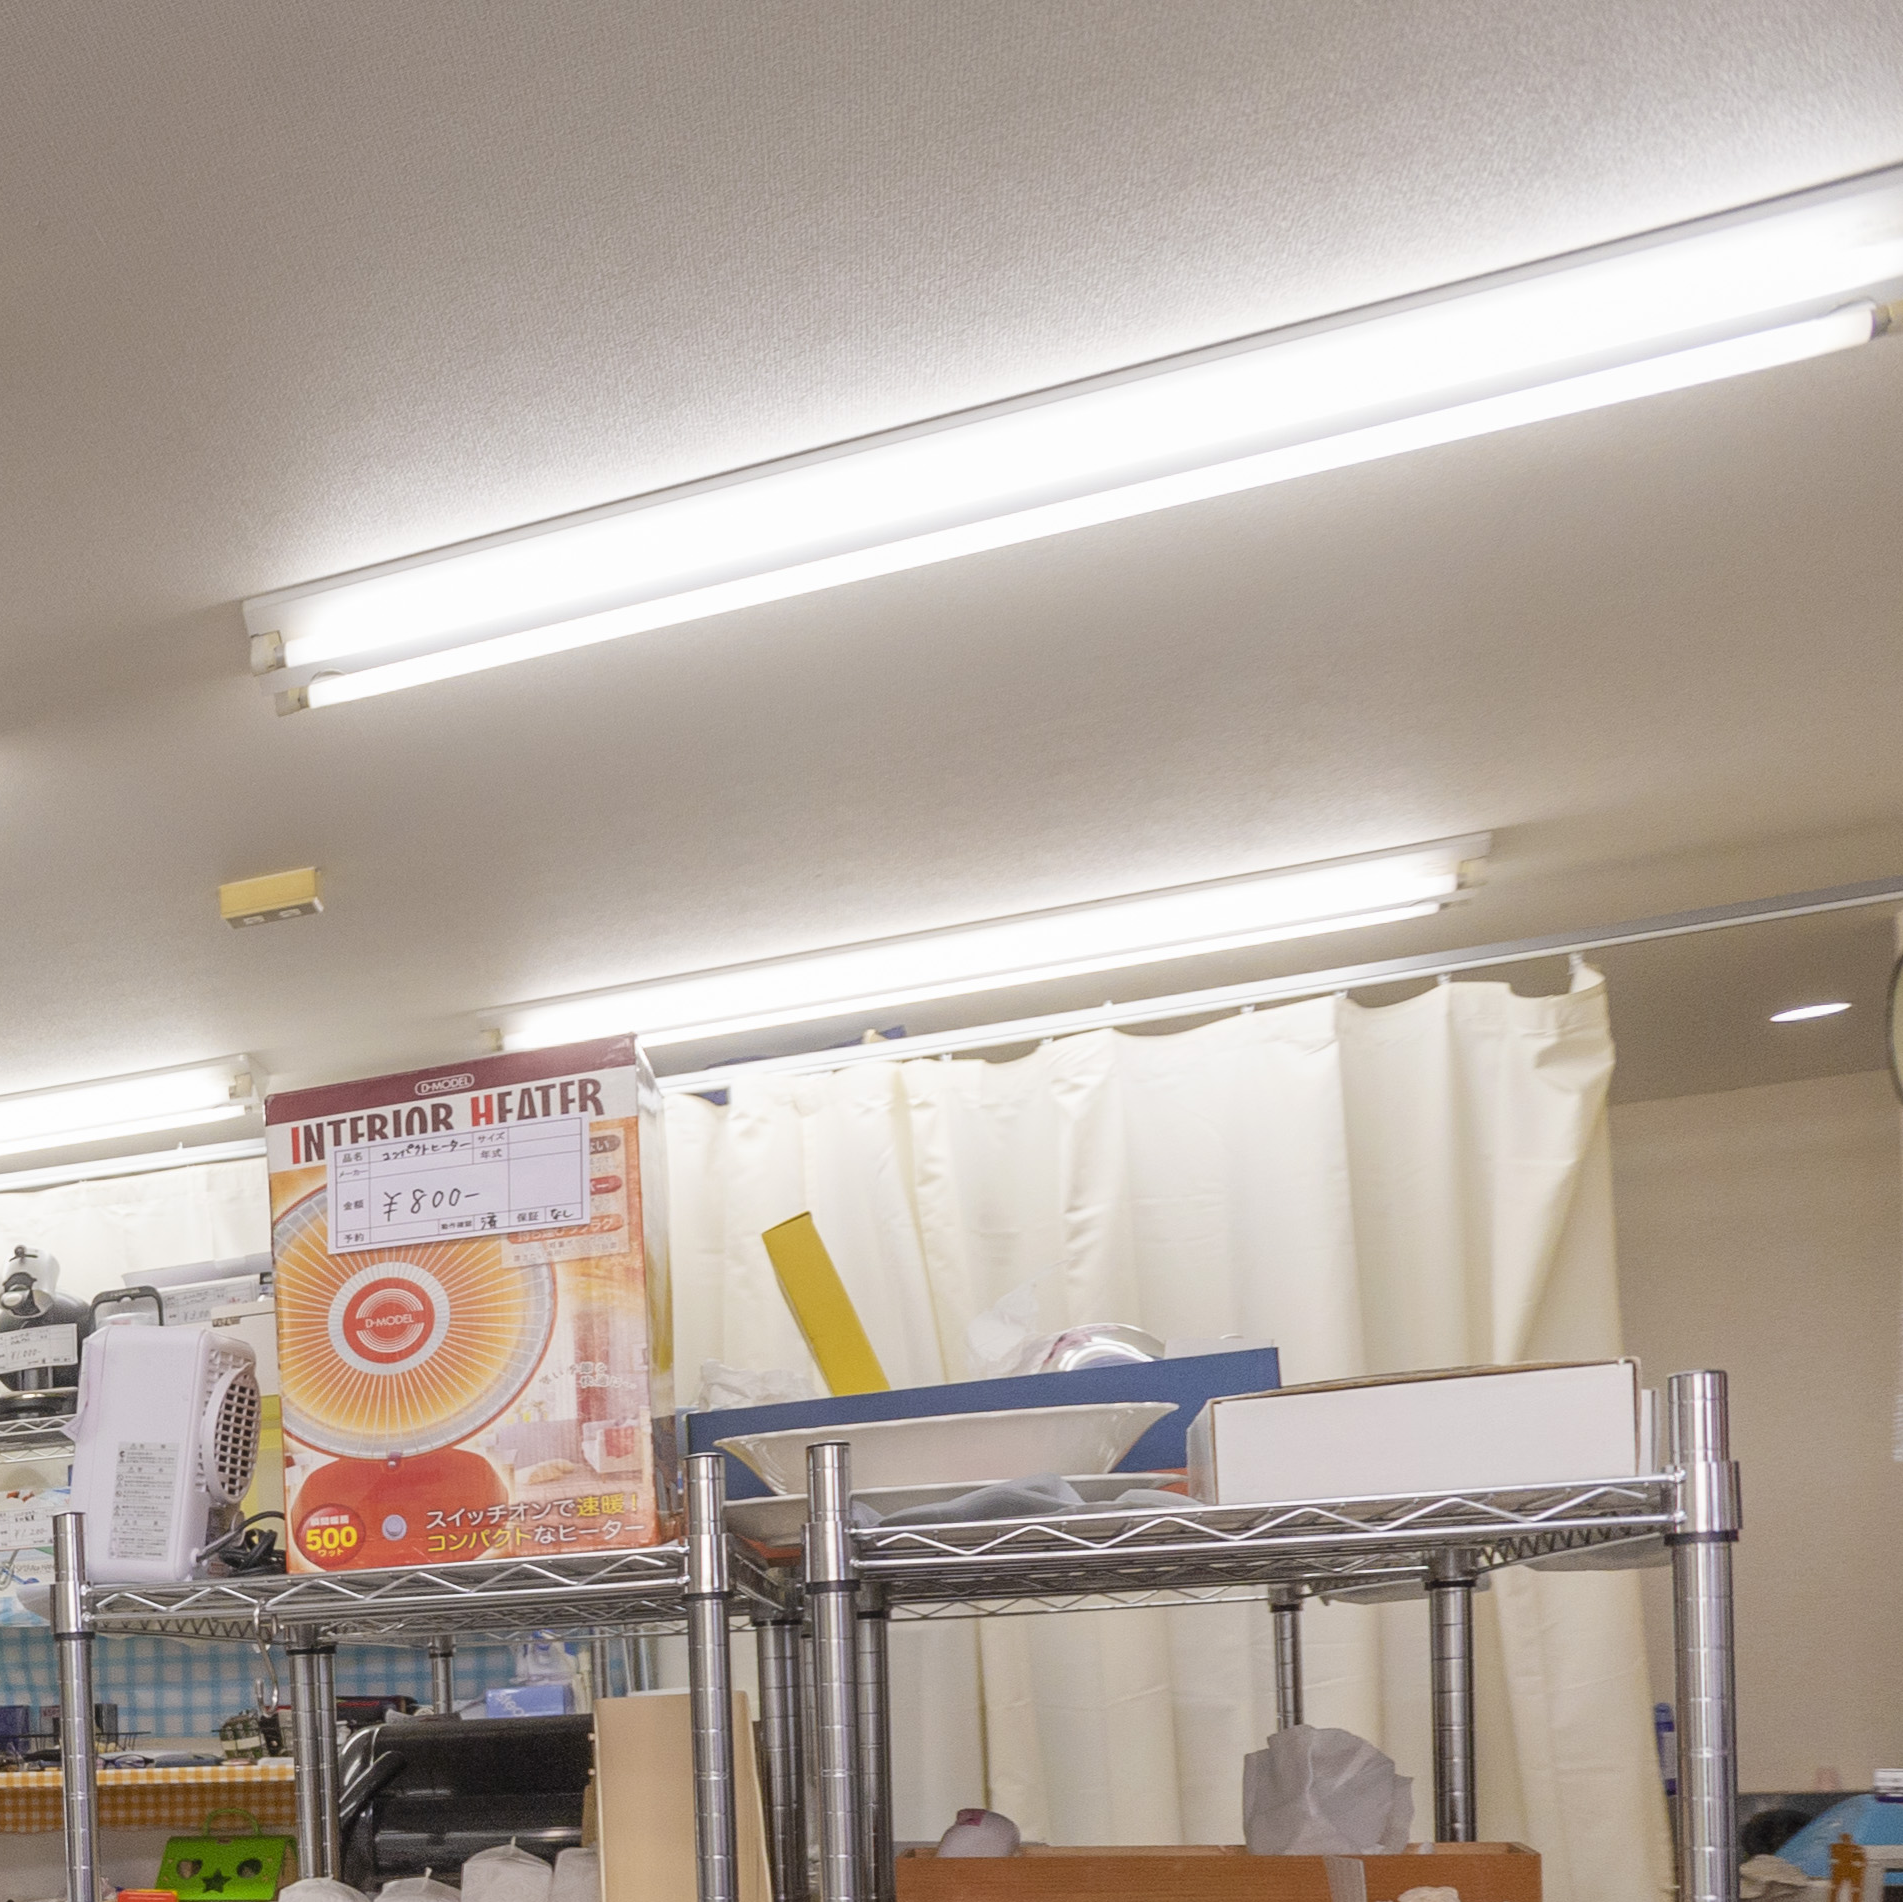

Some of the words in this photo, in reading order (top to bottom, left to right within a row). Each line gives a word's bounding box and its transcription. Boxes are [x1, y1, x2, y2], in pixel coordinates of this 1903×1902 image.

[419, 1076, 471, 1093] D-MODEL
[477, 1131, 505, 1143] サイズ
[342, 1152, 363, 1163] 品名
[480, 1148, 503, 1159] 年式
[338, 1168, 368, 1178] メーカー
[343, 1199, 364, 1211] 金額
[516, 1210, 539, 1223] 保証
[343, 1231, 365, 1243] 予約
[364, 1312, 415, 1329] D-MODEL
[305, 1526, 358, 1551] 500
[425, 1519, 645, 1553] コンパクトなヒーター
[318, 1547, 344, 1557] ワット
